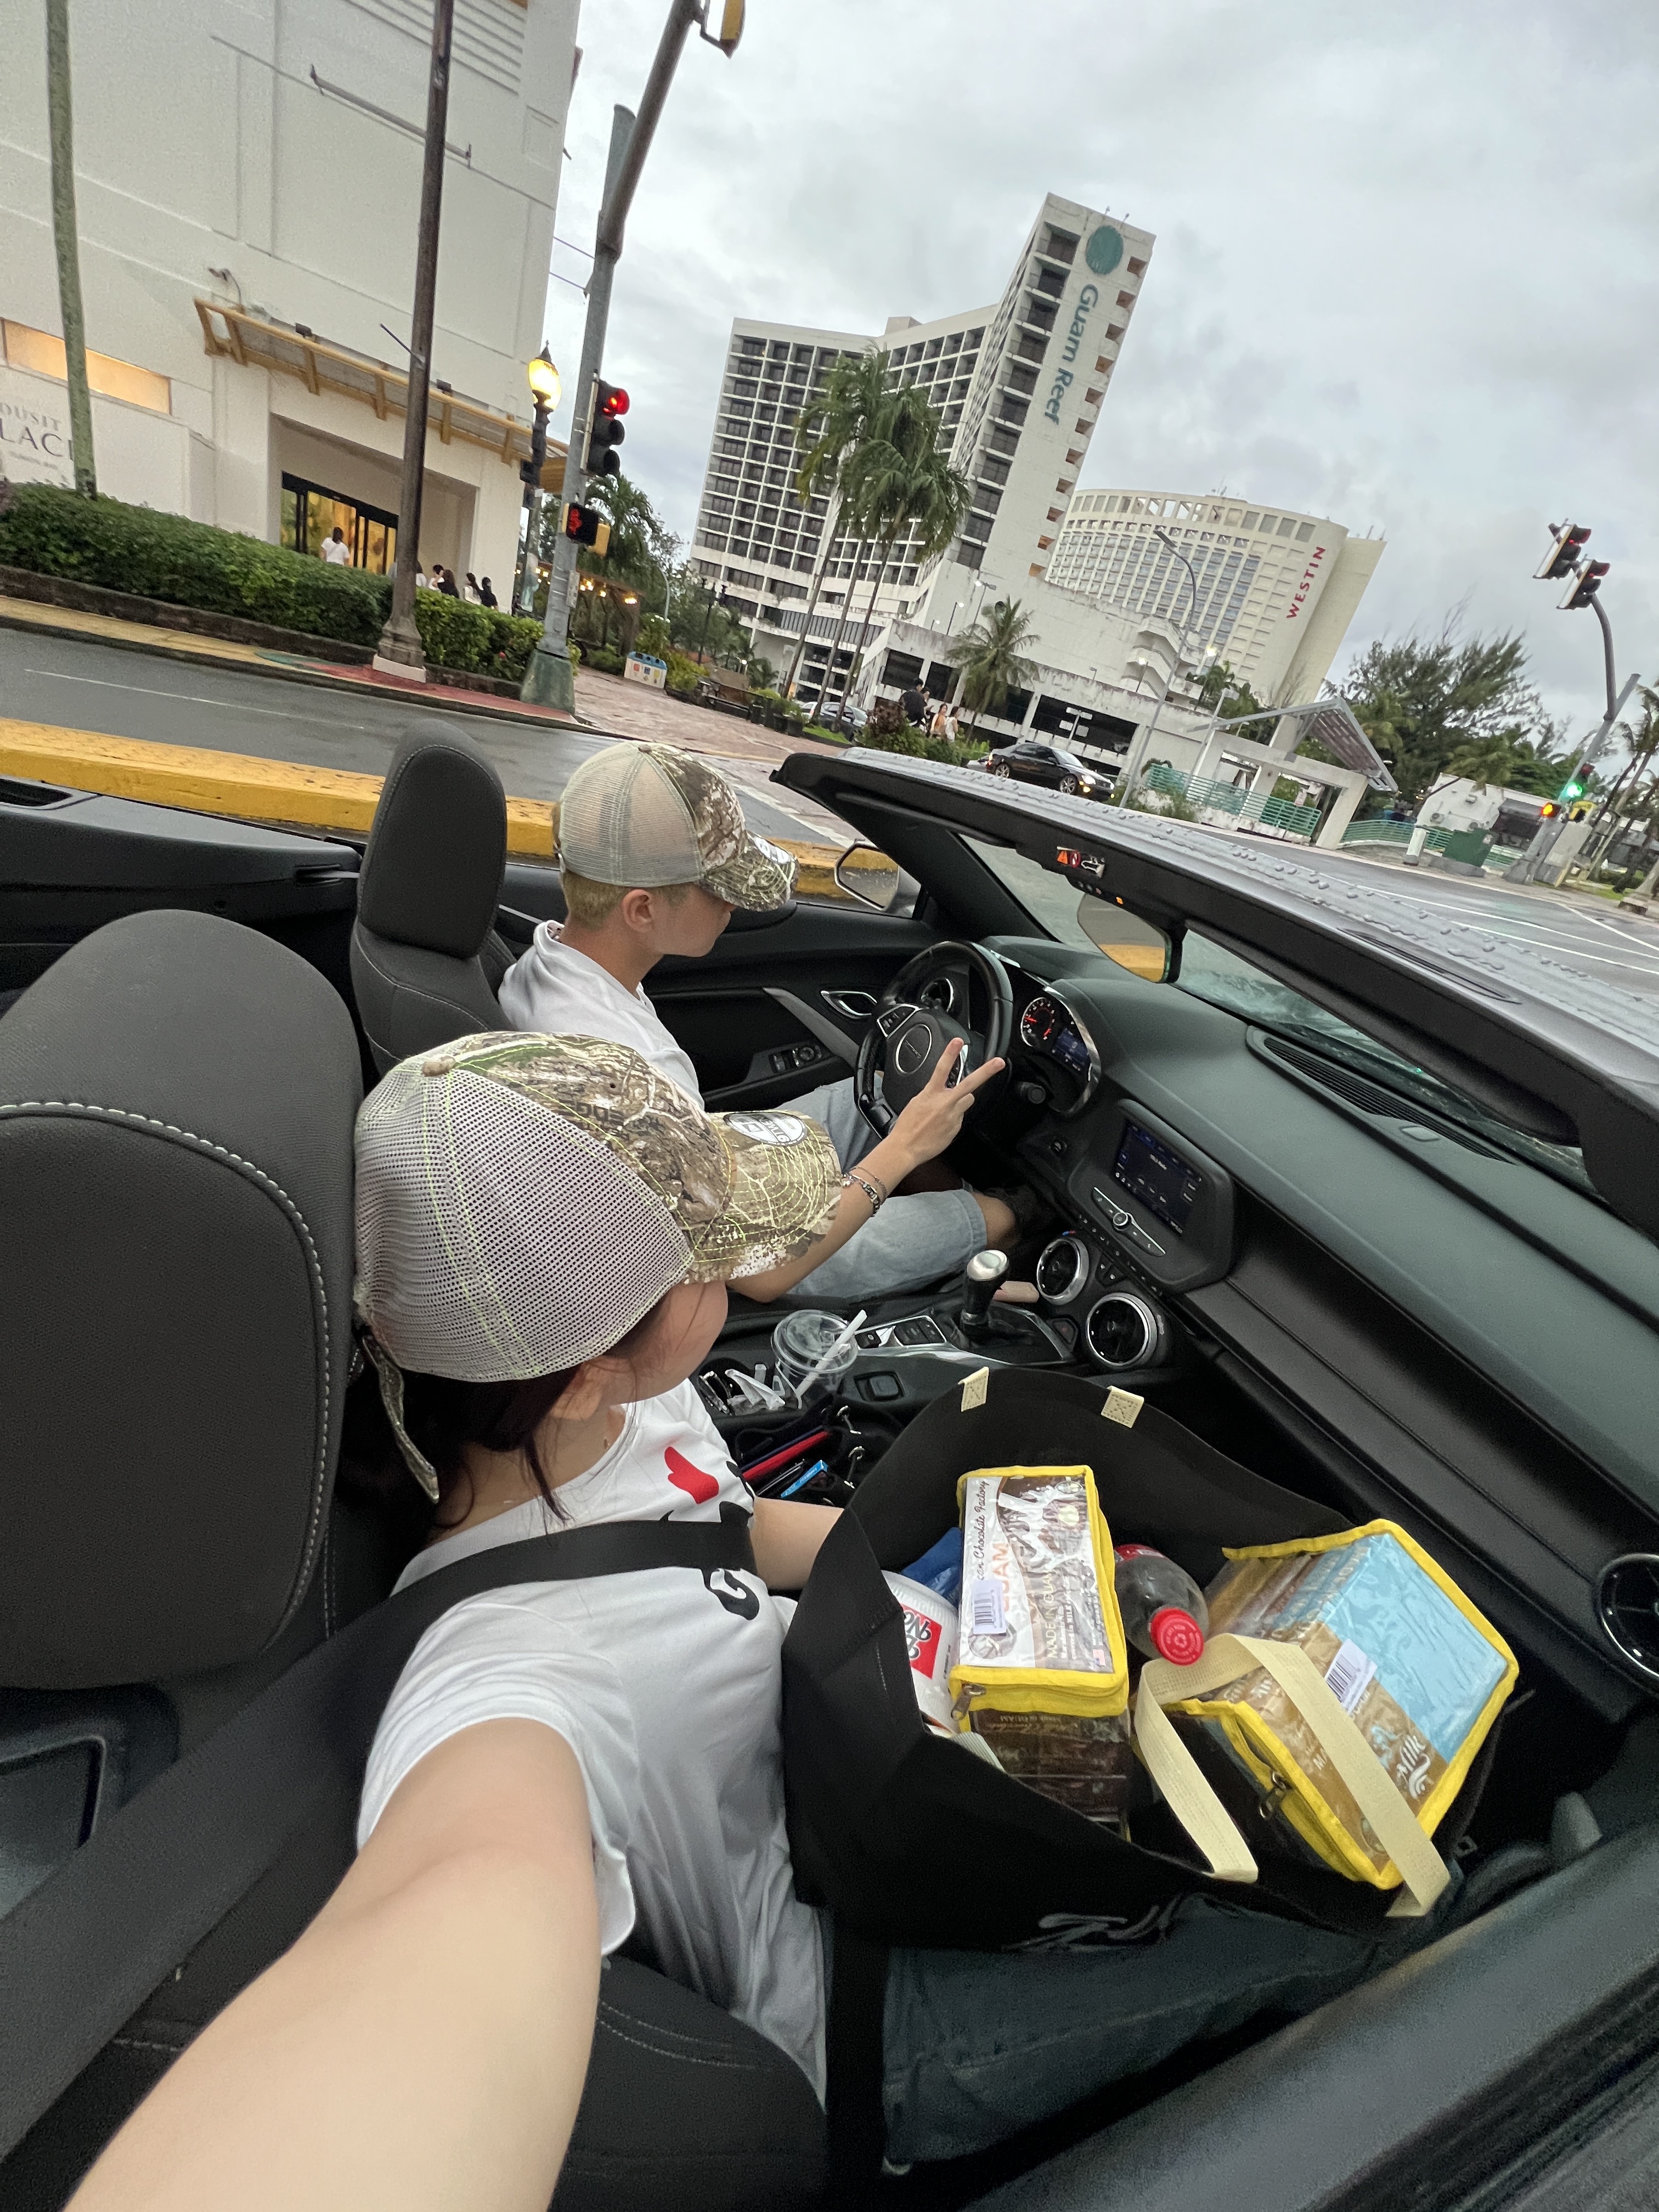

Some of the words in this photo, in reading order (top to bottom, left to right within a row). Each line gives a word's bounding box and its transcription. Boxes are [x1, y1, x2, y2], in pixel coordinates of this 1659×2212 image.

[1062, 284, 1099, 362] Guam
[0, 402, 63, 432] DUSIT
[1045, 368, 1074, 426] Reef
[1286, 546, 1326, 619] WESTIN
[974, 1480, 990, 1513] Factory
[973, 1514, 986, 1560] Chocolate
[1045, 1621, 1058, 1659] MADE
